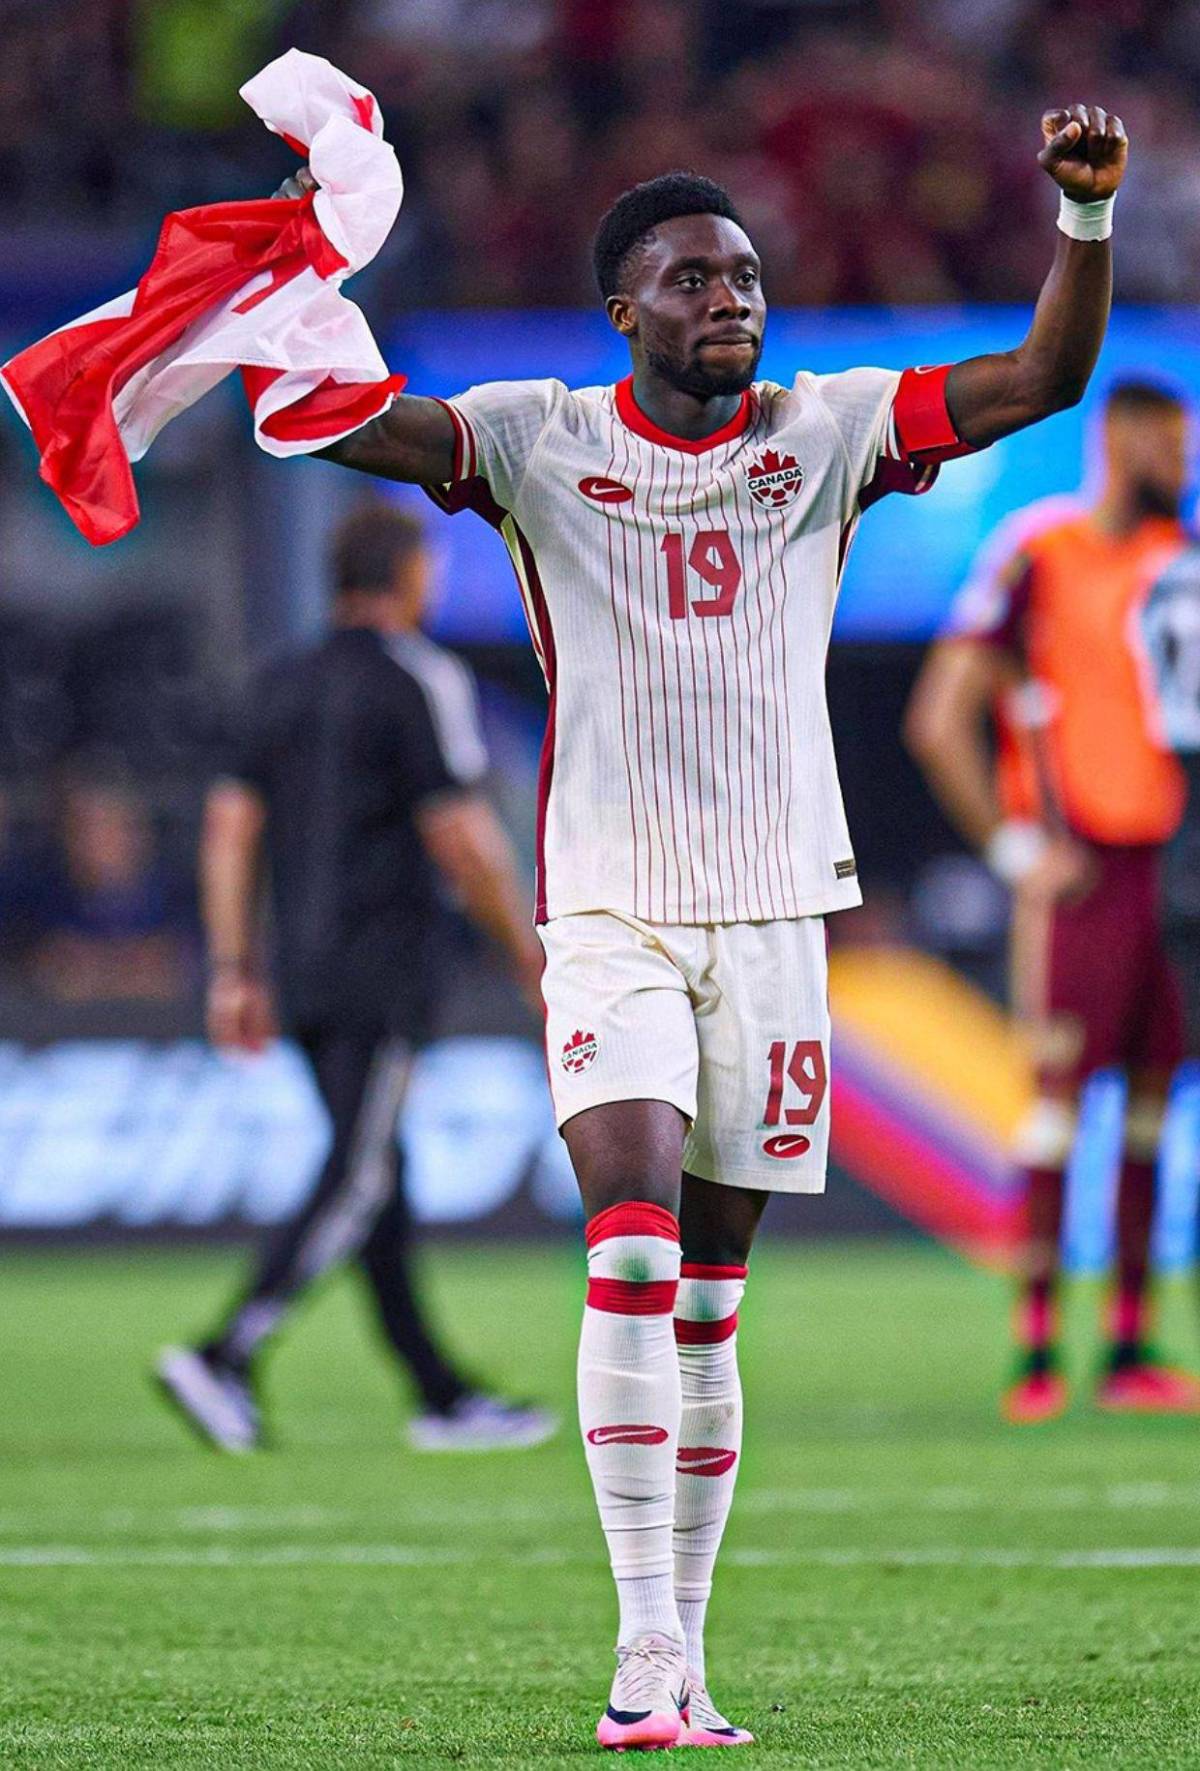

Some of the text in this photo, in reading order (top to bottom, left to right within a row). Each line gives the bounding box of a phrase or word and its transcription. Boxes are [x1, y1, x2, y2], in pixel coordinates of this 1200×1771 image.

[748, 469, 803, 490] CANADA
[660, 530, 742, 619] 19
[561, 1042, 597, 1062] CANADA
[763, 1040, 827, 1126] 19
